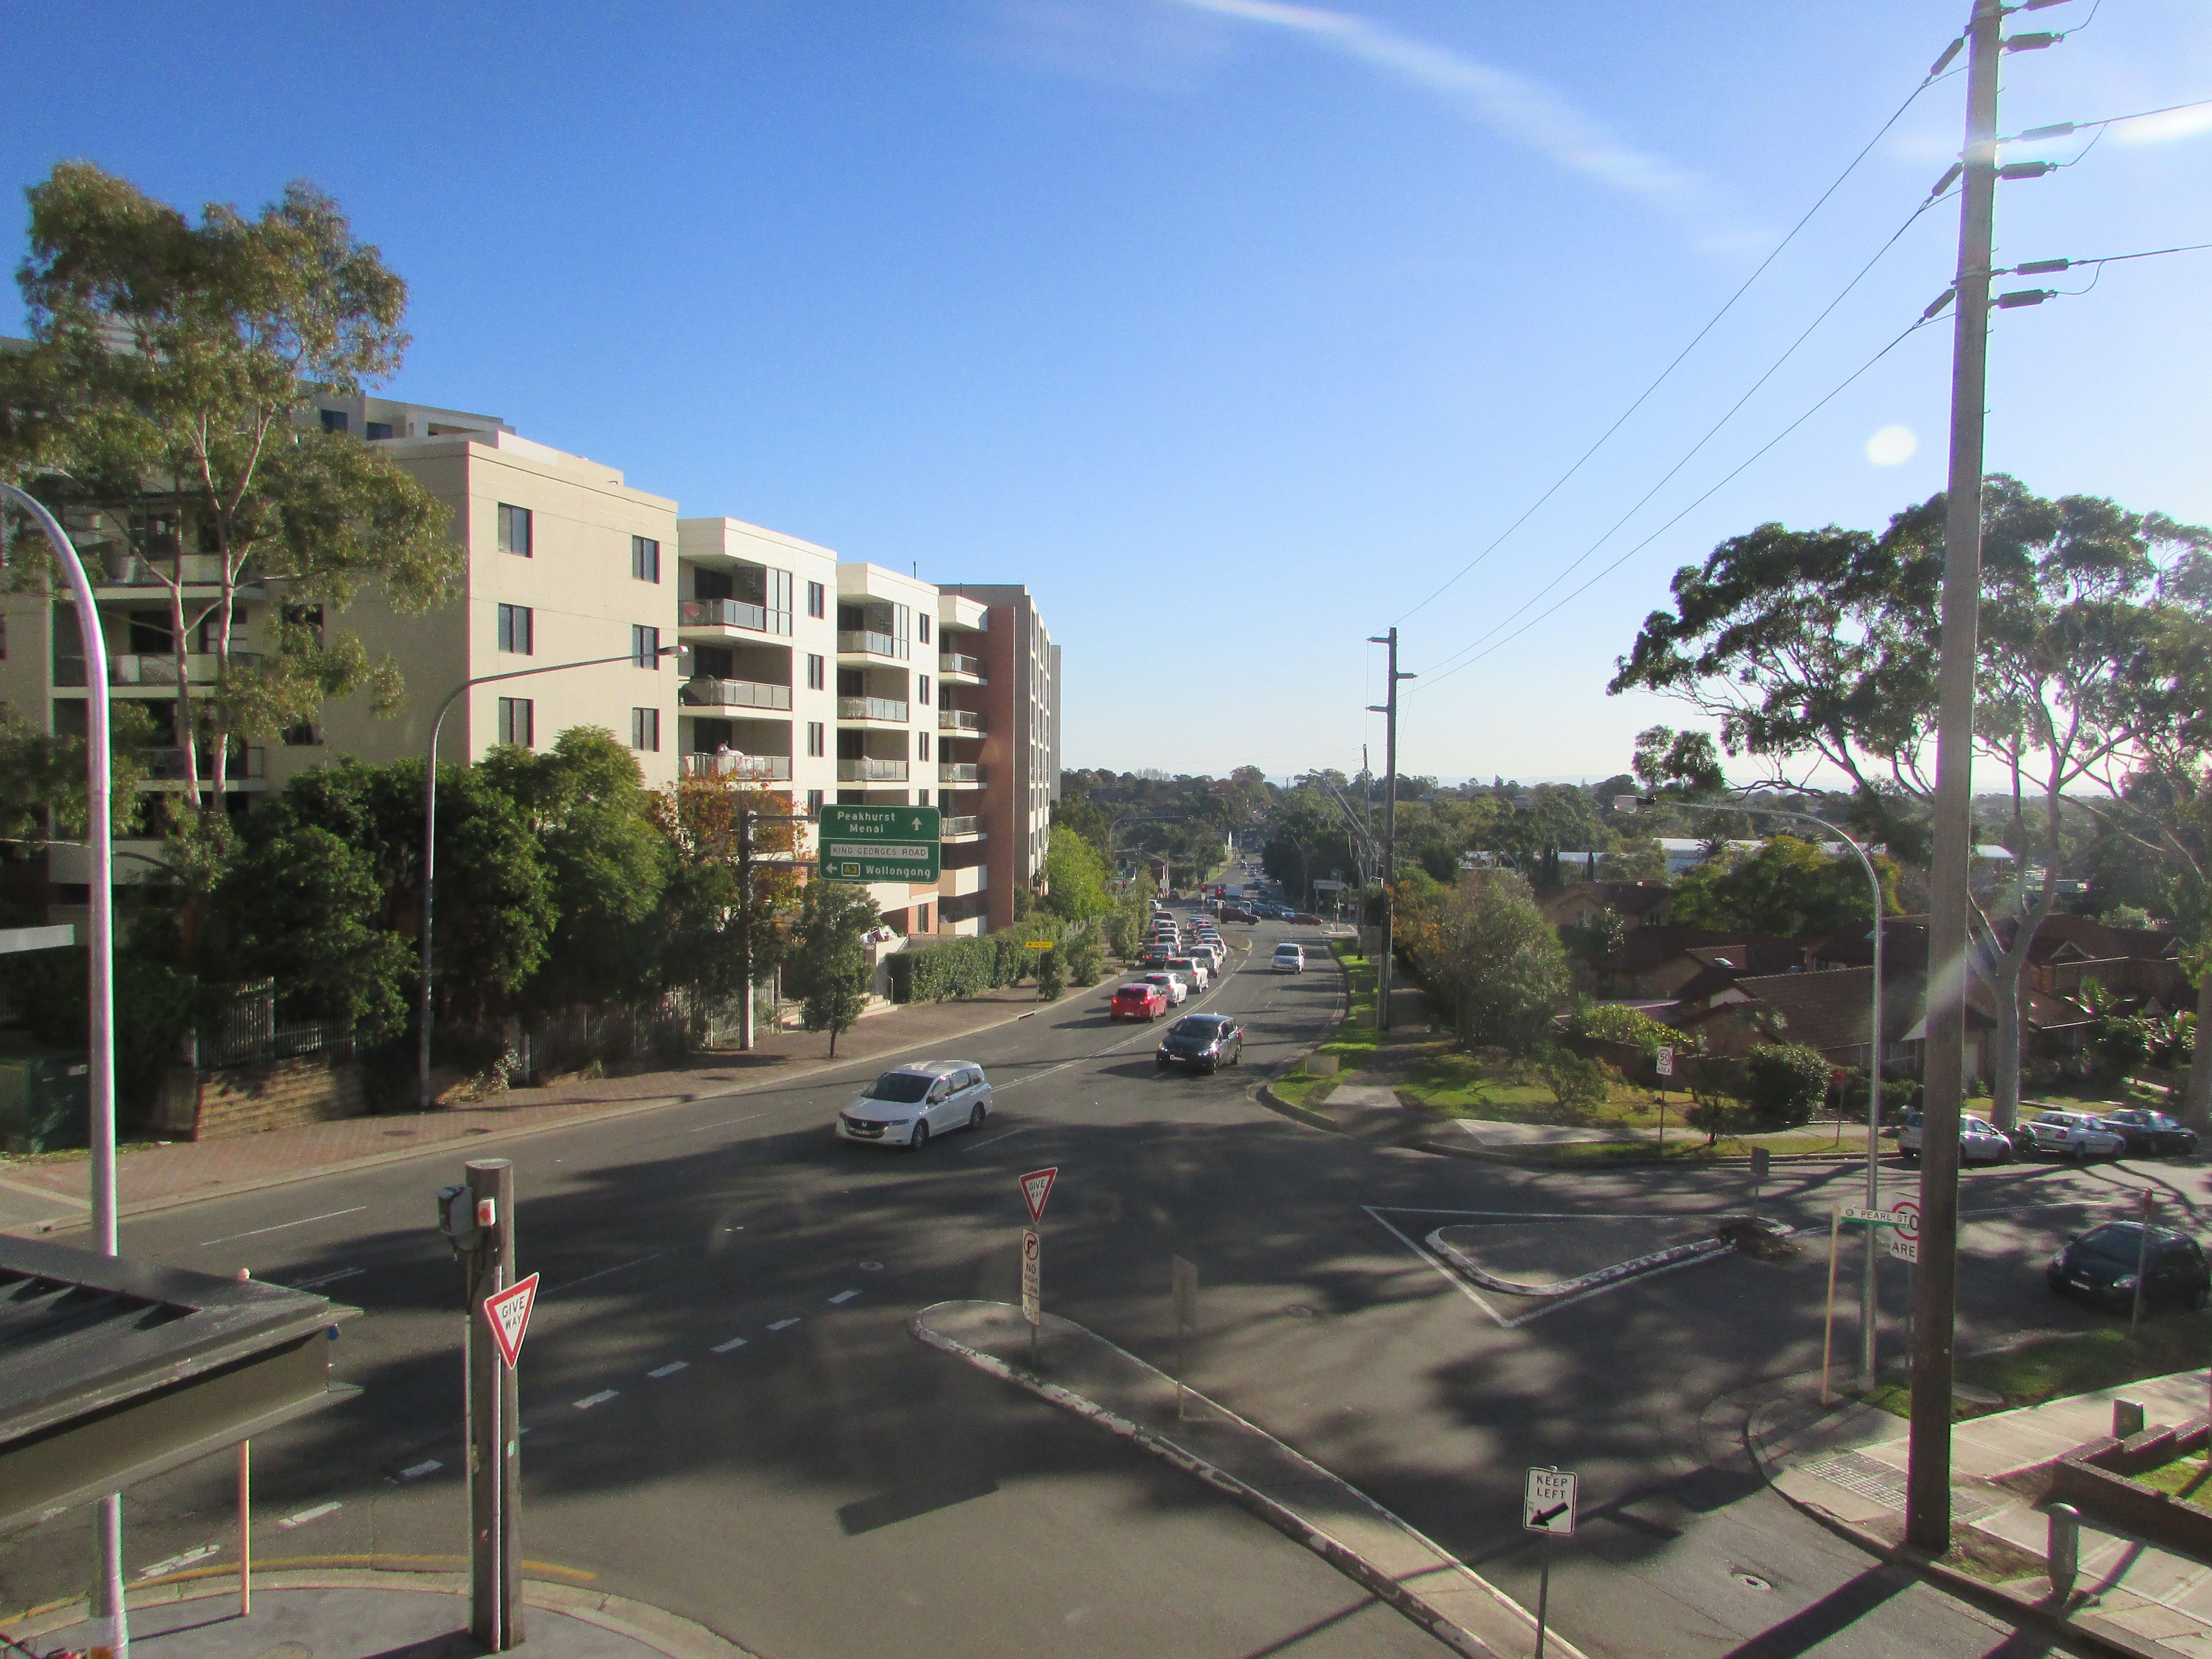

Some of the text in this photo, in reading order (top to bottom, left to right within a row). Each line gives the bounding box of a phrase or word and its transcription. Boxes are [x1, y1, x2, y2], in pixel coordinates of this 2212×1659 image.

[838, 810, 896, 821] Peakhurst
[850, 824, 884, 833] Menai
[857, 847, 897, 855] GEORGES
[902, 849, 926, 857] ROAD
[844, 865, 931, 878] A3 Wollongong
[1660, 1052, 1670, 1062] 50
[1029, 1179, 1045, 1191] GIVE
[1031, 1191, 1042, 1199] WAY
[1861, 1210, 1908, 1222] PEARL ST
[1892, 1241, 1915, 1257] ARE
[1026, 1262, 1036, 1274] NO
[1024, 1273, 1038, 1285] RIGHT
[502, 1296, 525, 1318] GIVE
[505, 1313, 522, 1330] WAY
[1536, 1475, 1568, 1487] KEEP
[1537, 1487, 1566, 1499] LEFT
